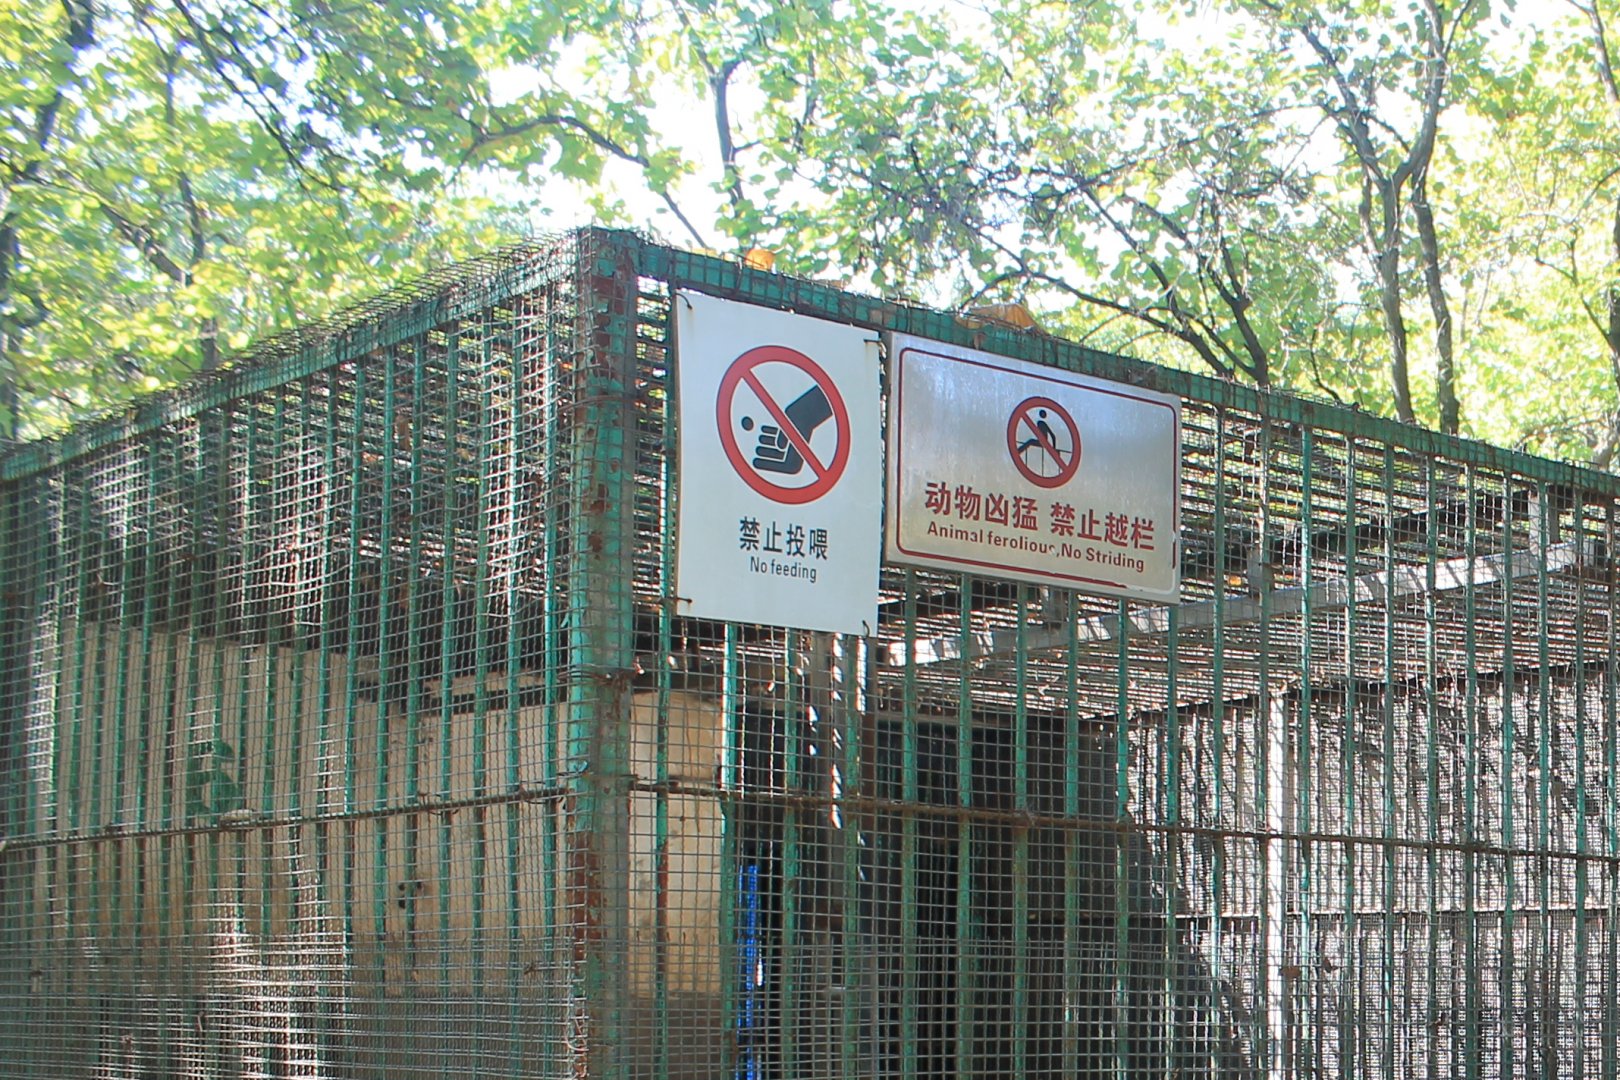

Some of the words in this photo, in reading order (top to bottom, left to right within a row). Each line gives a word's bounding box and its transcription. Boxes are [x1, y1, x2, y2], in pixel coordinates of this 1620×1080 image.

[739, 516, 828, 560] 禁止投喂
[924, 481, 1038, 531] 动物凶猛
[1050, 502, 1154, 551] 禁止越栏
[750, 556, 768, 573] No
[771, 559, 817, 584] feeding
[927, 521, 983, 543] Animal
[1086, 547, 1144, 573] Striding
